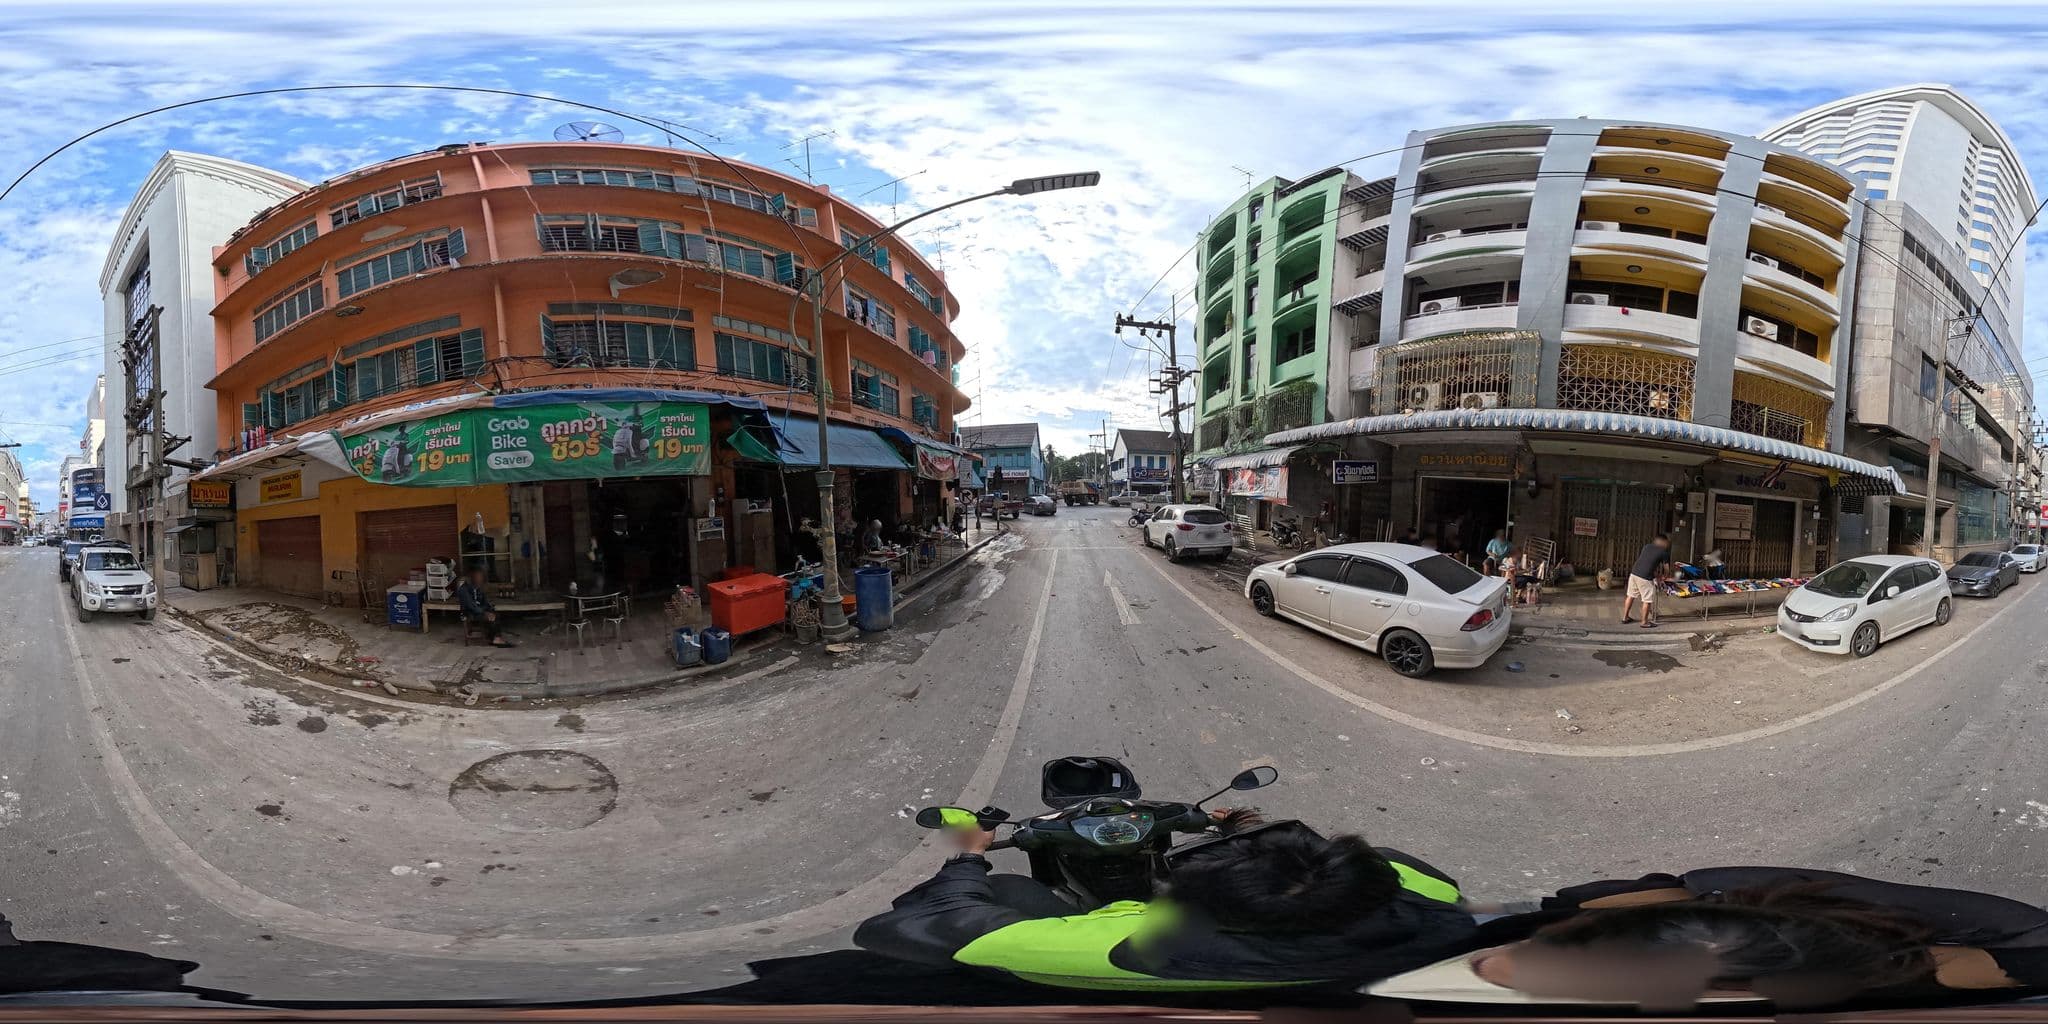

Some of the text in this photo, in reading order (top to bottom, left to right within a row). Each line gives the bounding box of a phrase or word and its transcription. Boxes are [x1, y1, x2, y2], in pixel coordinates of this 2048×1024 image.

[487, 416, 530, 433] Grab
[659, 412, 695, 424] ราคาใหม่
[425, 421, 462, 435] ราคาใหม่
[541, 411, 608, 443] ถูกกว่า
[661, 422, 696, 437] เริ่มต้น
[424, 434, 461, 451] เริ่มต้น
[491, 435, 527, 450] Bike
[551, 431, 602, 462] ชัวร์
[653, 438, 704, 461] 19 บาท
[417, 450, 472, 473] 19 บาท
[494, 454, 528, 466] Saver
